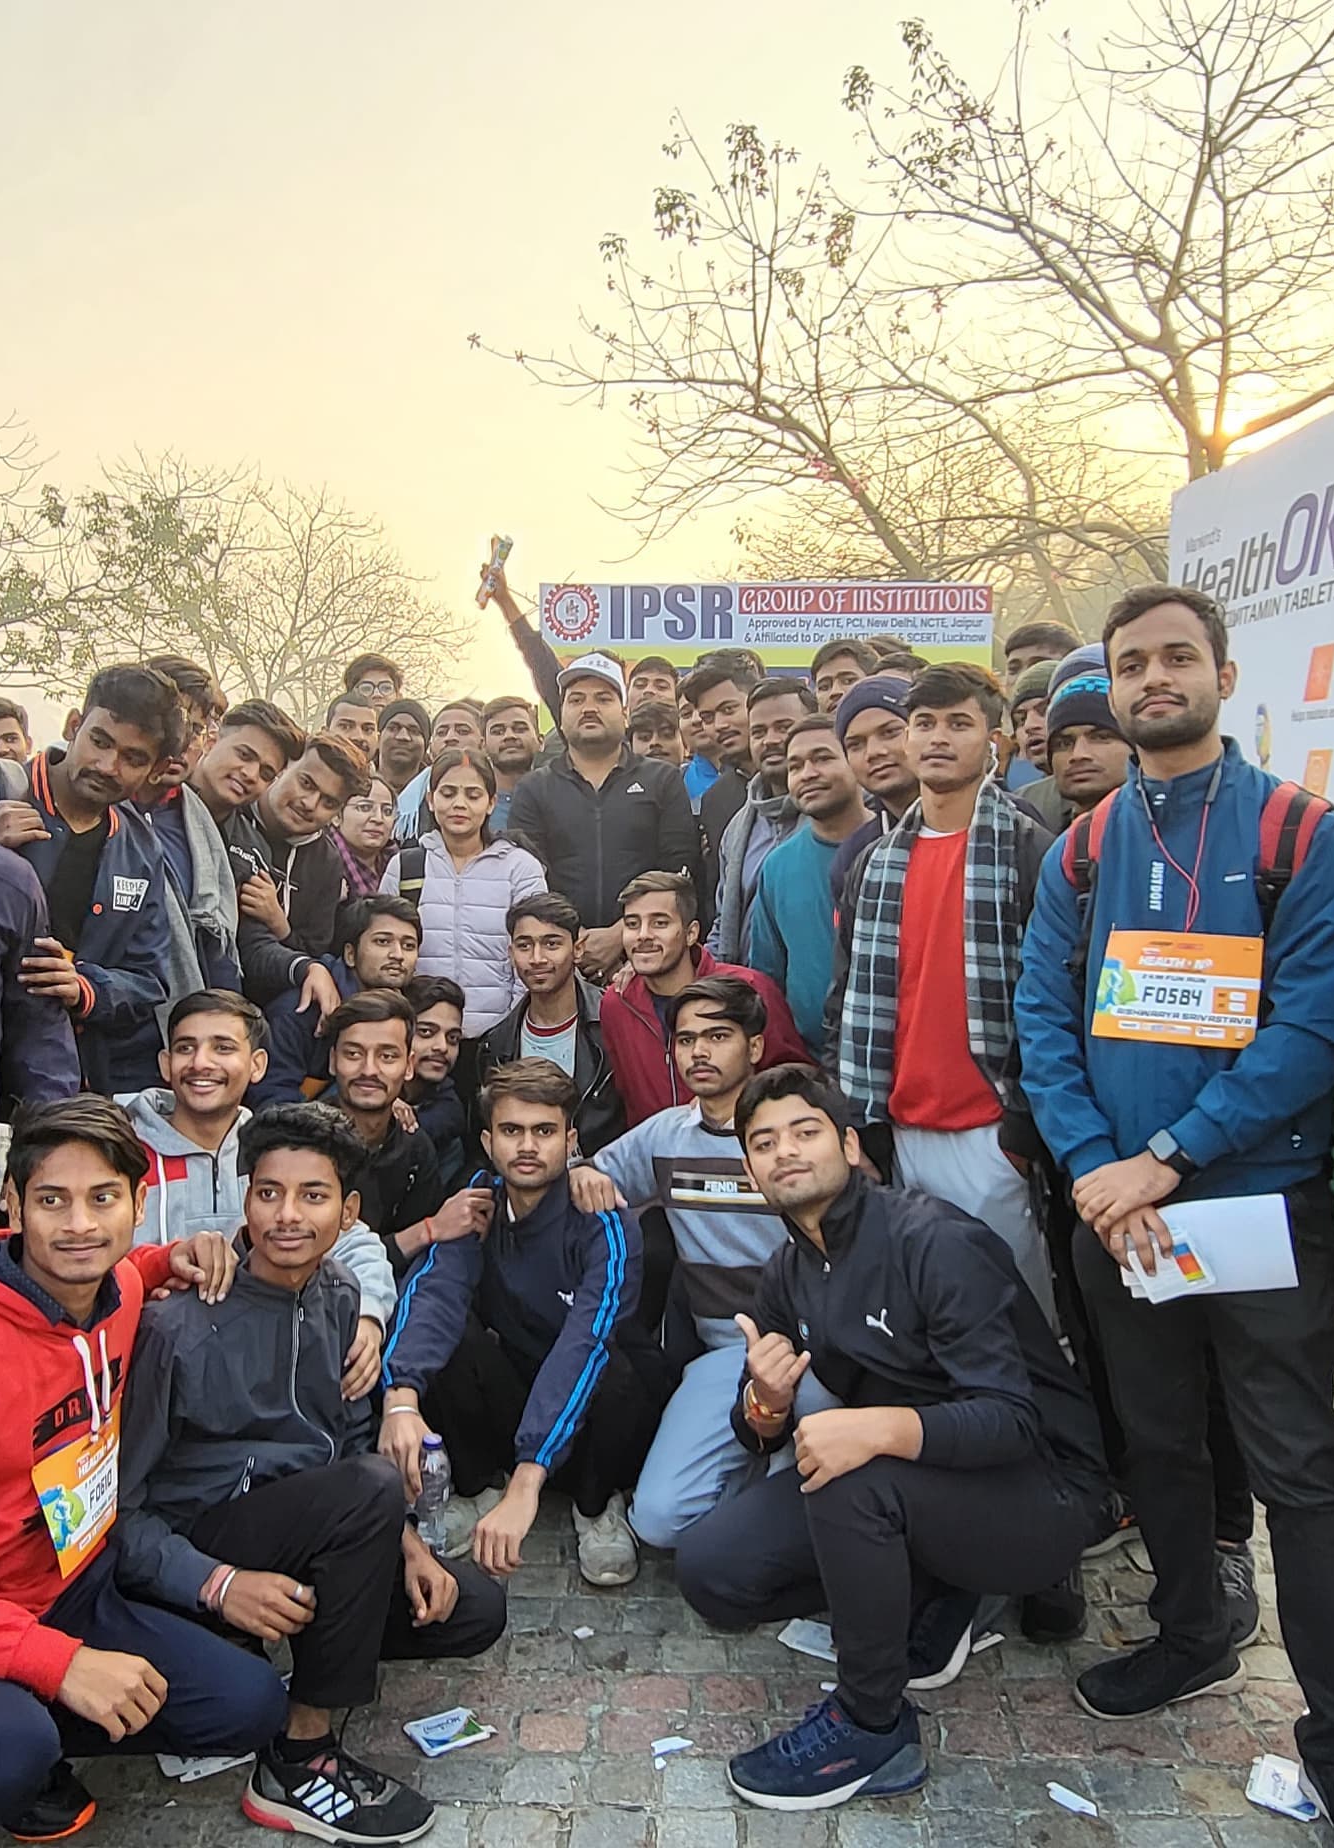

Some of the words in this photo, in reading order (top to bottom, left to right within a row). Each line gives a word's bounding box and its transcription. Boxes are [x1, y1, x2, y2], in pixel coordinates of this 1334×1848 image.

[741, 588, 814, 613] GROUP
[818, 588, 849, 613] OF
[609, 584, 733, 640] IPSR
[747, 617, 797, 629] Approved
[799, 616, 811, 630] by
[867, 617, 889, 629] New
[950, 617, 984, 630] Jaipur
[744, 633, 751, 643] &
[753, 632, 799, 643] Affiliated
[801, 633, 812, 643] to
[813, 633, 826, 643] Dr.
[942, 632, 987, 643] Lucknow
[1142, 986, 1203, 1007] F0584
[703, 1180, 739, 1193] FENDI
